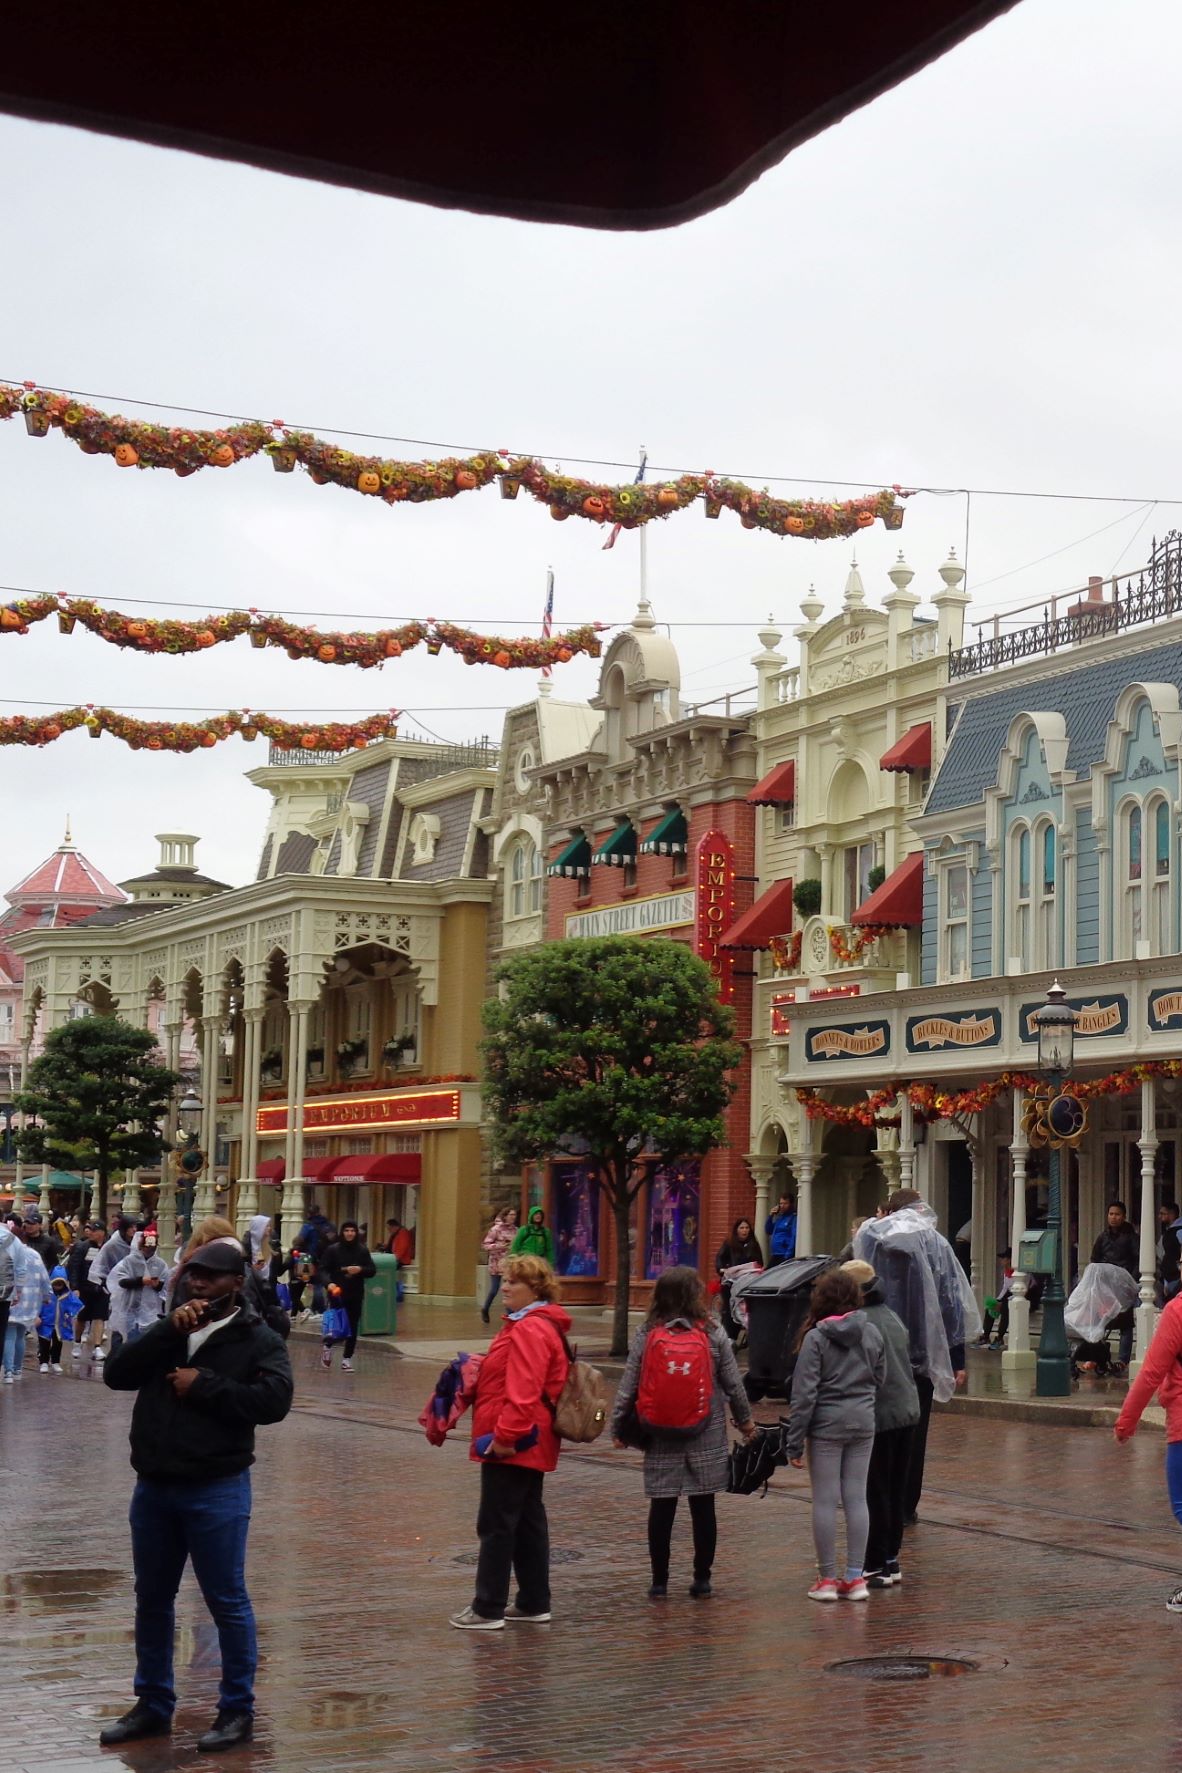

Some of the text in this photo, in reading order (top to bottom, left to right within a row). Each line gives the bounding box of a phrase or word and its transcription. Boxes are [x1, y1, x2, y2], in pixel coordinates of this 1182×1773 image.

[846, 627, 866, 646] 1896
[603, 906, 637, 934] STREET
[640, 897, 680, 928] GAZETTE
[1158, 997, 1173, 1016] BOW
[917, 1021, 947, 1040] BUCKLES
[956, 1022, 988, 1042] BUTTONS
[1082, 1012, 1116, 1031] BANGLES
[309, 1102, 392, 1124] EMPORIUM
